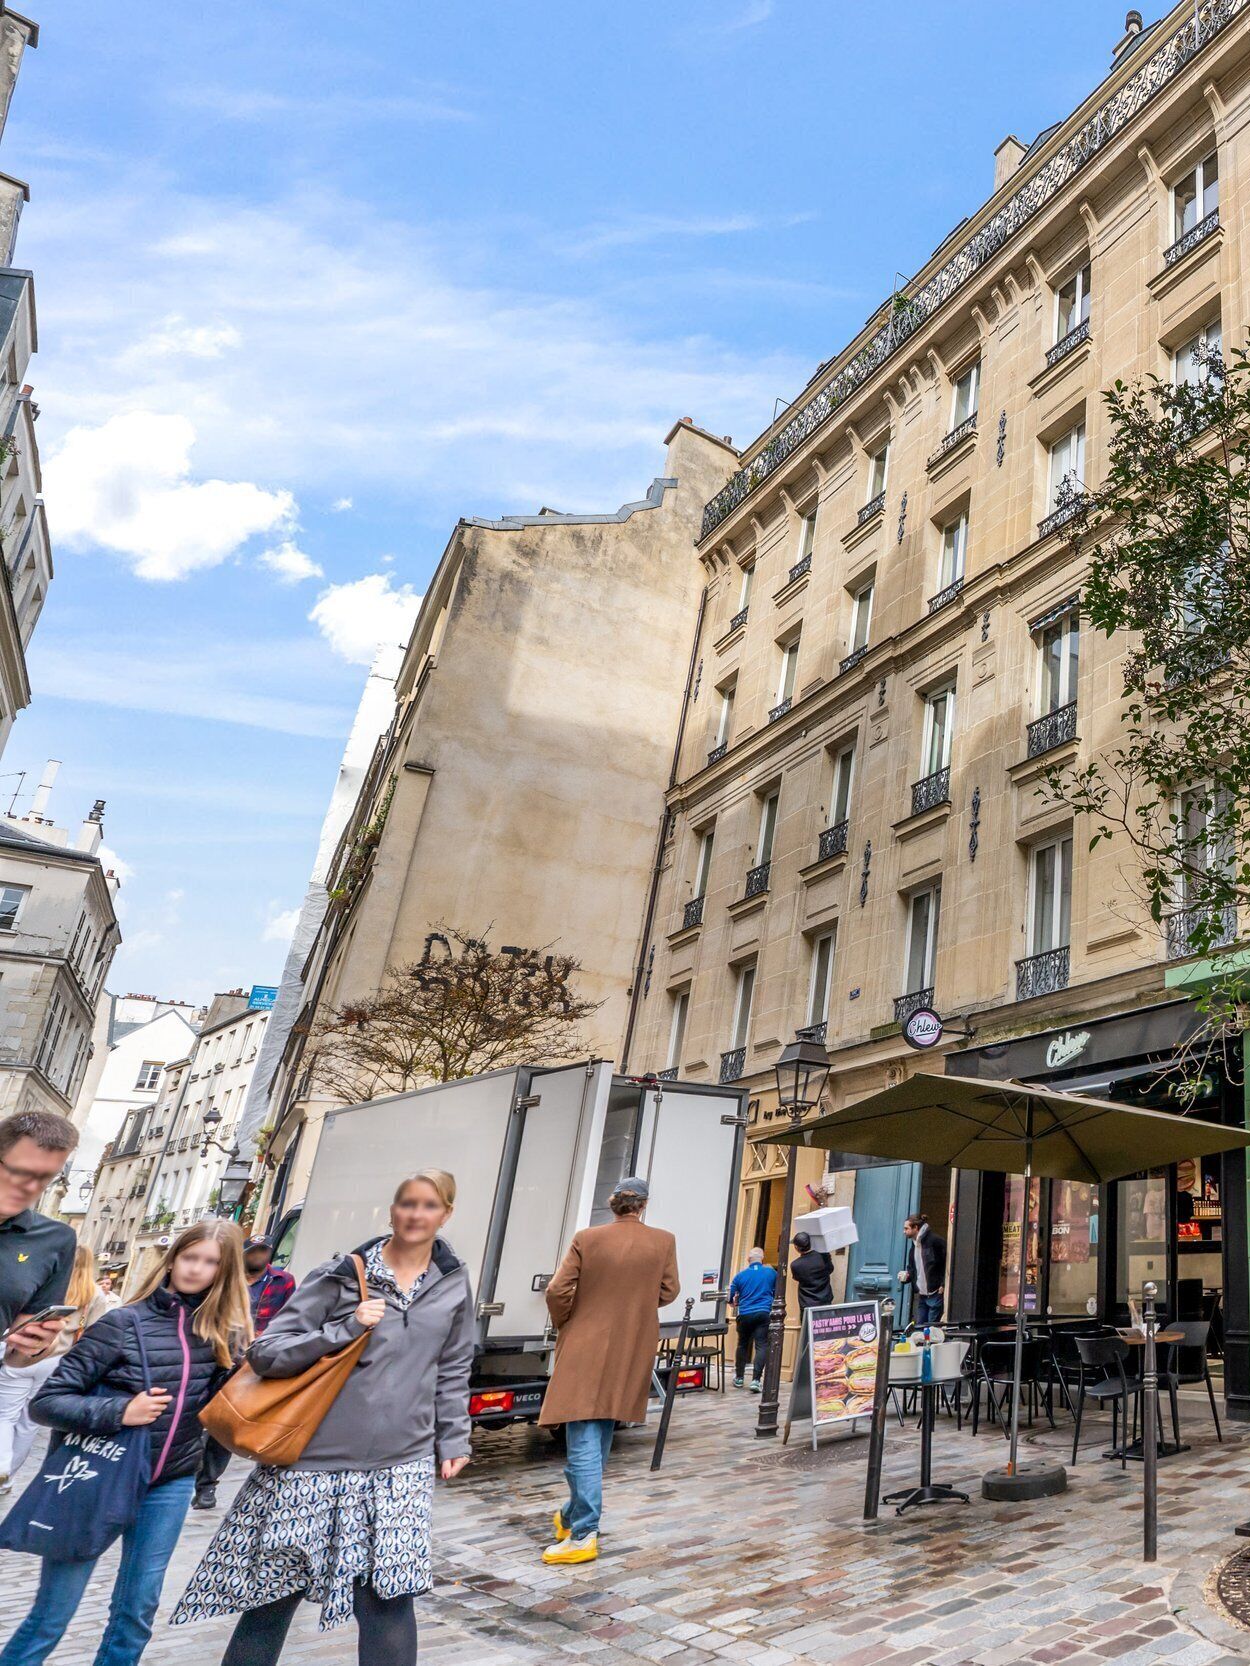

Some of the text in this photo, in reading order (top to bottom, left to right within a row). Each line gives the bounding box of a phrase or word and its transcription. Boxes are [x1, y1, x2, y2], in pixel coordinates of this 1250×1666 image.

[1003, 1224, 1020, 1233] MEAT
[1052, 1227, 1070, 1235] BON
[844, 1315, 856, 1324] POUR
[857, 1315, 863, 1323] LA
[514, 1393, 541, 1402] IVECO
